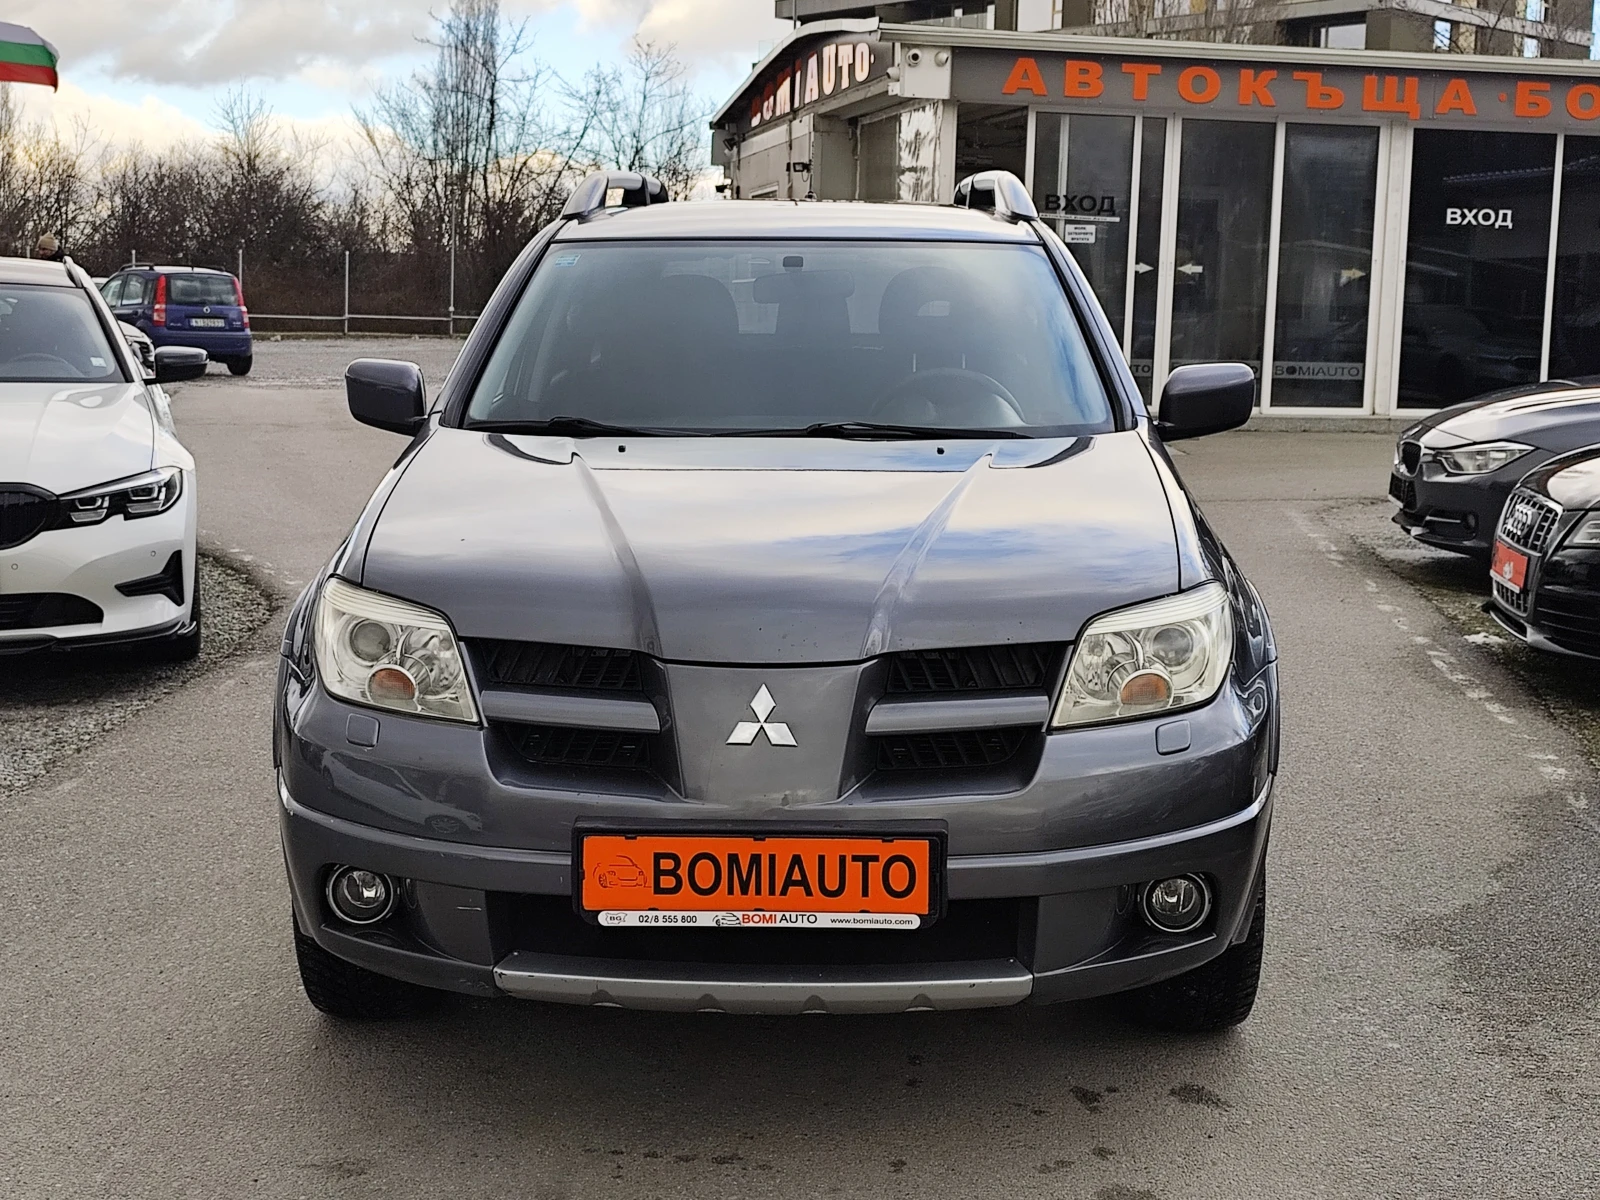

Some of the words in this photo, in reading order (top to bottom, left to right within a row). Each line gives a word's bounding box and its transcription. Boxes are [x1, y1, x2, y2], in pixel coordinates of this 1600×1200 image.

[1002, 57, 1477, 120] АВТОКЪЩА
[1045, 194, 1116, 216] ВХОД
[1446, 208, 1513, 229] ВХОД
[1275, 365, 1360, 377] BOMIAUTO
[653, 852, 917, 899] BOMIAUTO
[638, 914, 659, 924] 02/8
[662, 914, 678, 924] 555
[681, 914, 697, 924] 800
[742, 913, 777, 924] BOMI
[779, 913, 818, 924] AUTO
[830, 917, 913, 926] www.bomiauto.com
